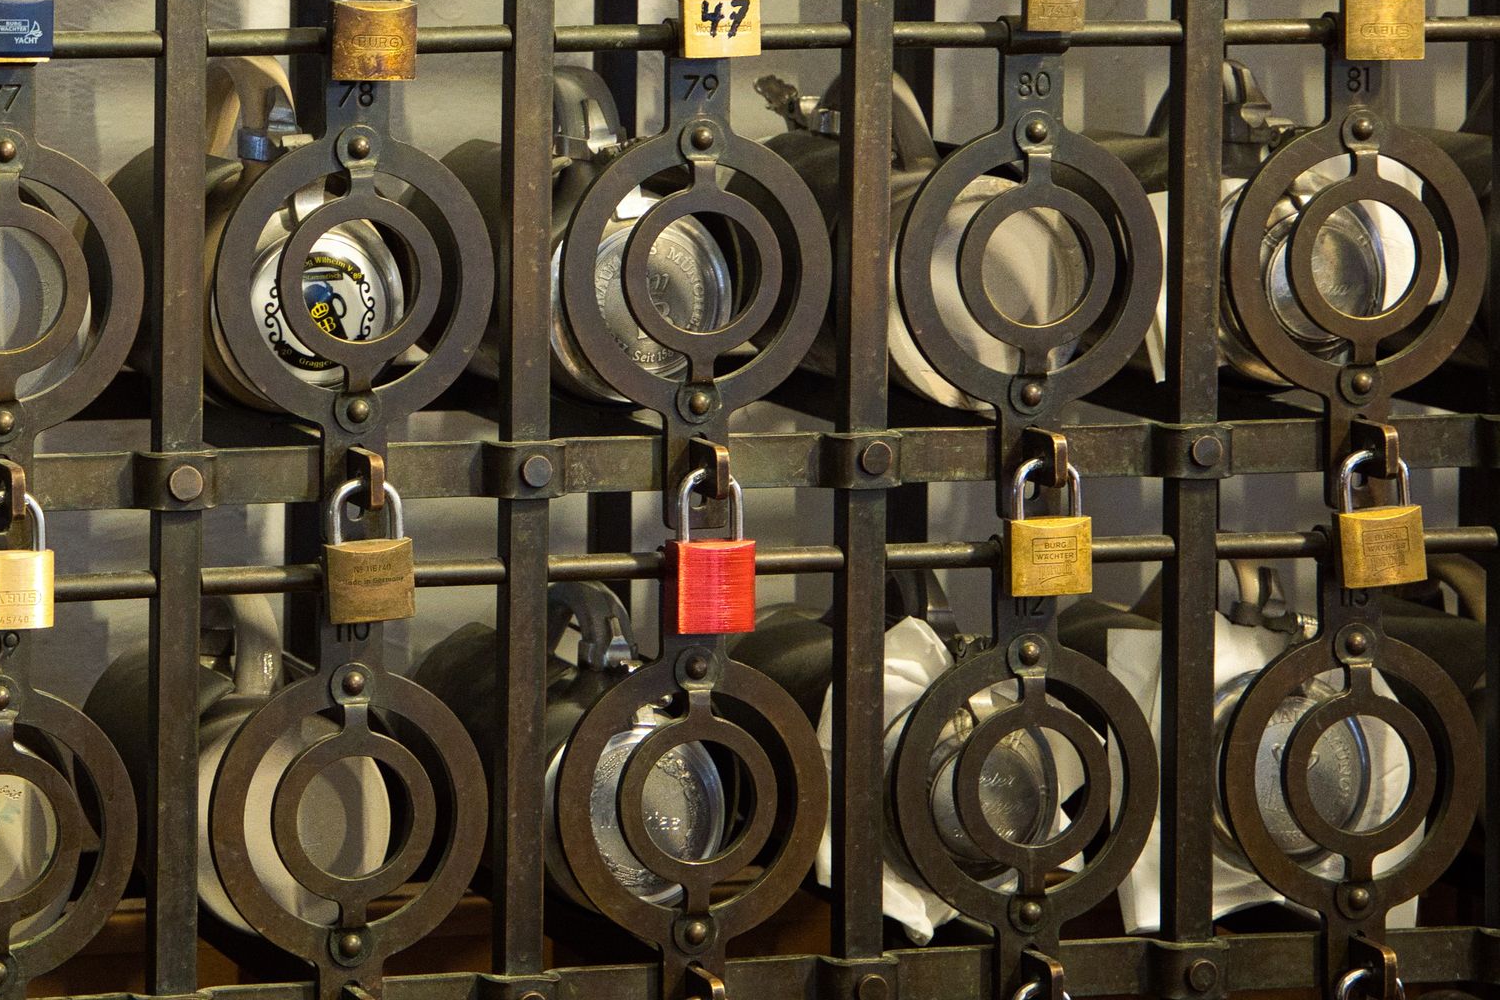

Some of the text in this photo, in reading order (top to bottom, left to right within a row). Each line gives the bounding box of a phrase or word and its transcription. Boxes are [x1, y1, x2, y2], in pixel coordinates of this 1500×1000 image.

[13, 36, 40, 45] YACHT
[683, 73, 720, 102] 79
[1018, 71, 1052, 98] 80
[1347, 66, 1370, 93] 81
[338, 80, 374, 108] 78
[314, 255, 346, 269] Wilhelm
[632, 350, 656, 363] Seit
[1044, 542, 1068, 550] BURG
